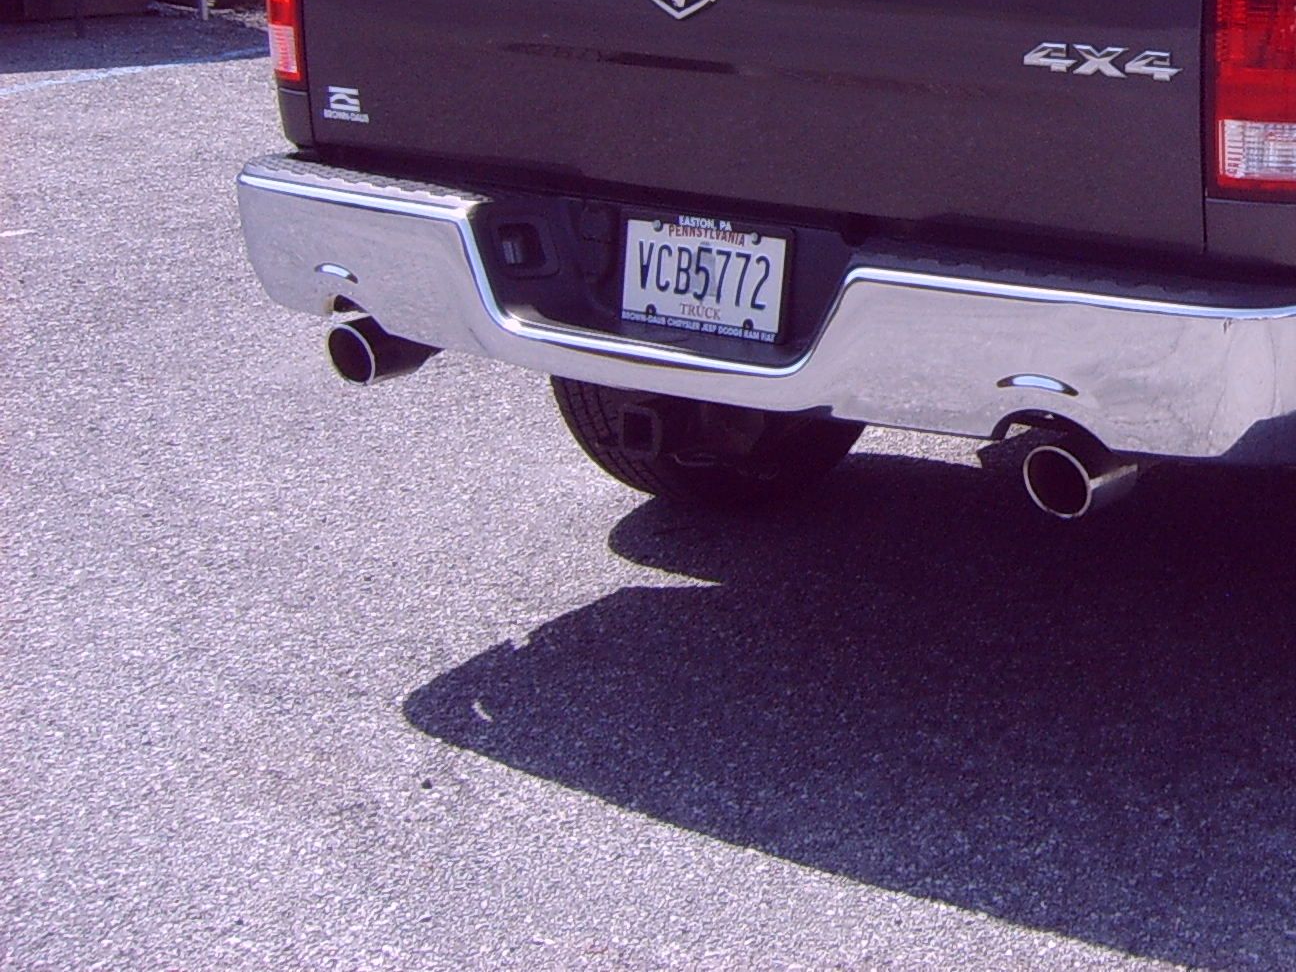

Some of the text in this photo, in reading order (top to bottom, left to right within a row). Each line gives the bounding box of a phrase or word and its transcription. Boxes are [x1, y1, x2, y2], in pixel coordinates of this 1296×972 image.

[668, 224, 745, 247] PENNSYLVANIA
[719, 219, 733, 232] PA
[638, 240, 771, 311] VCB5772
[680, 302, 721, 321] TRUCK
